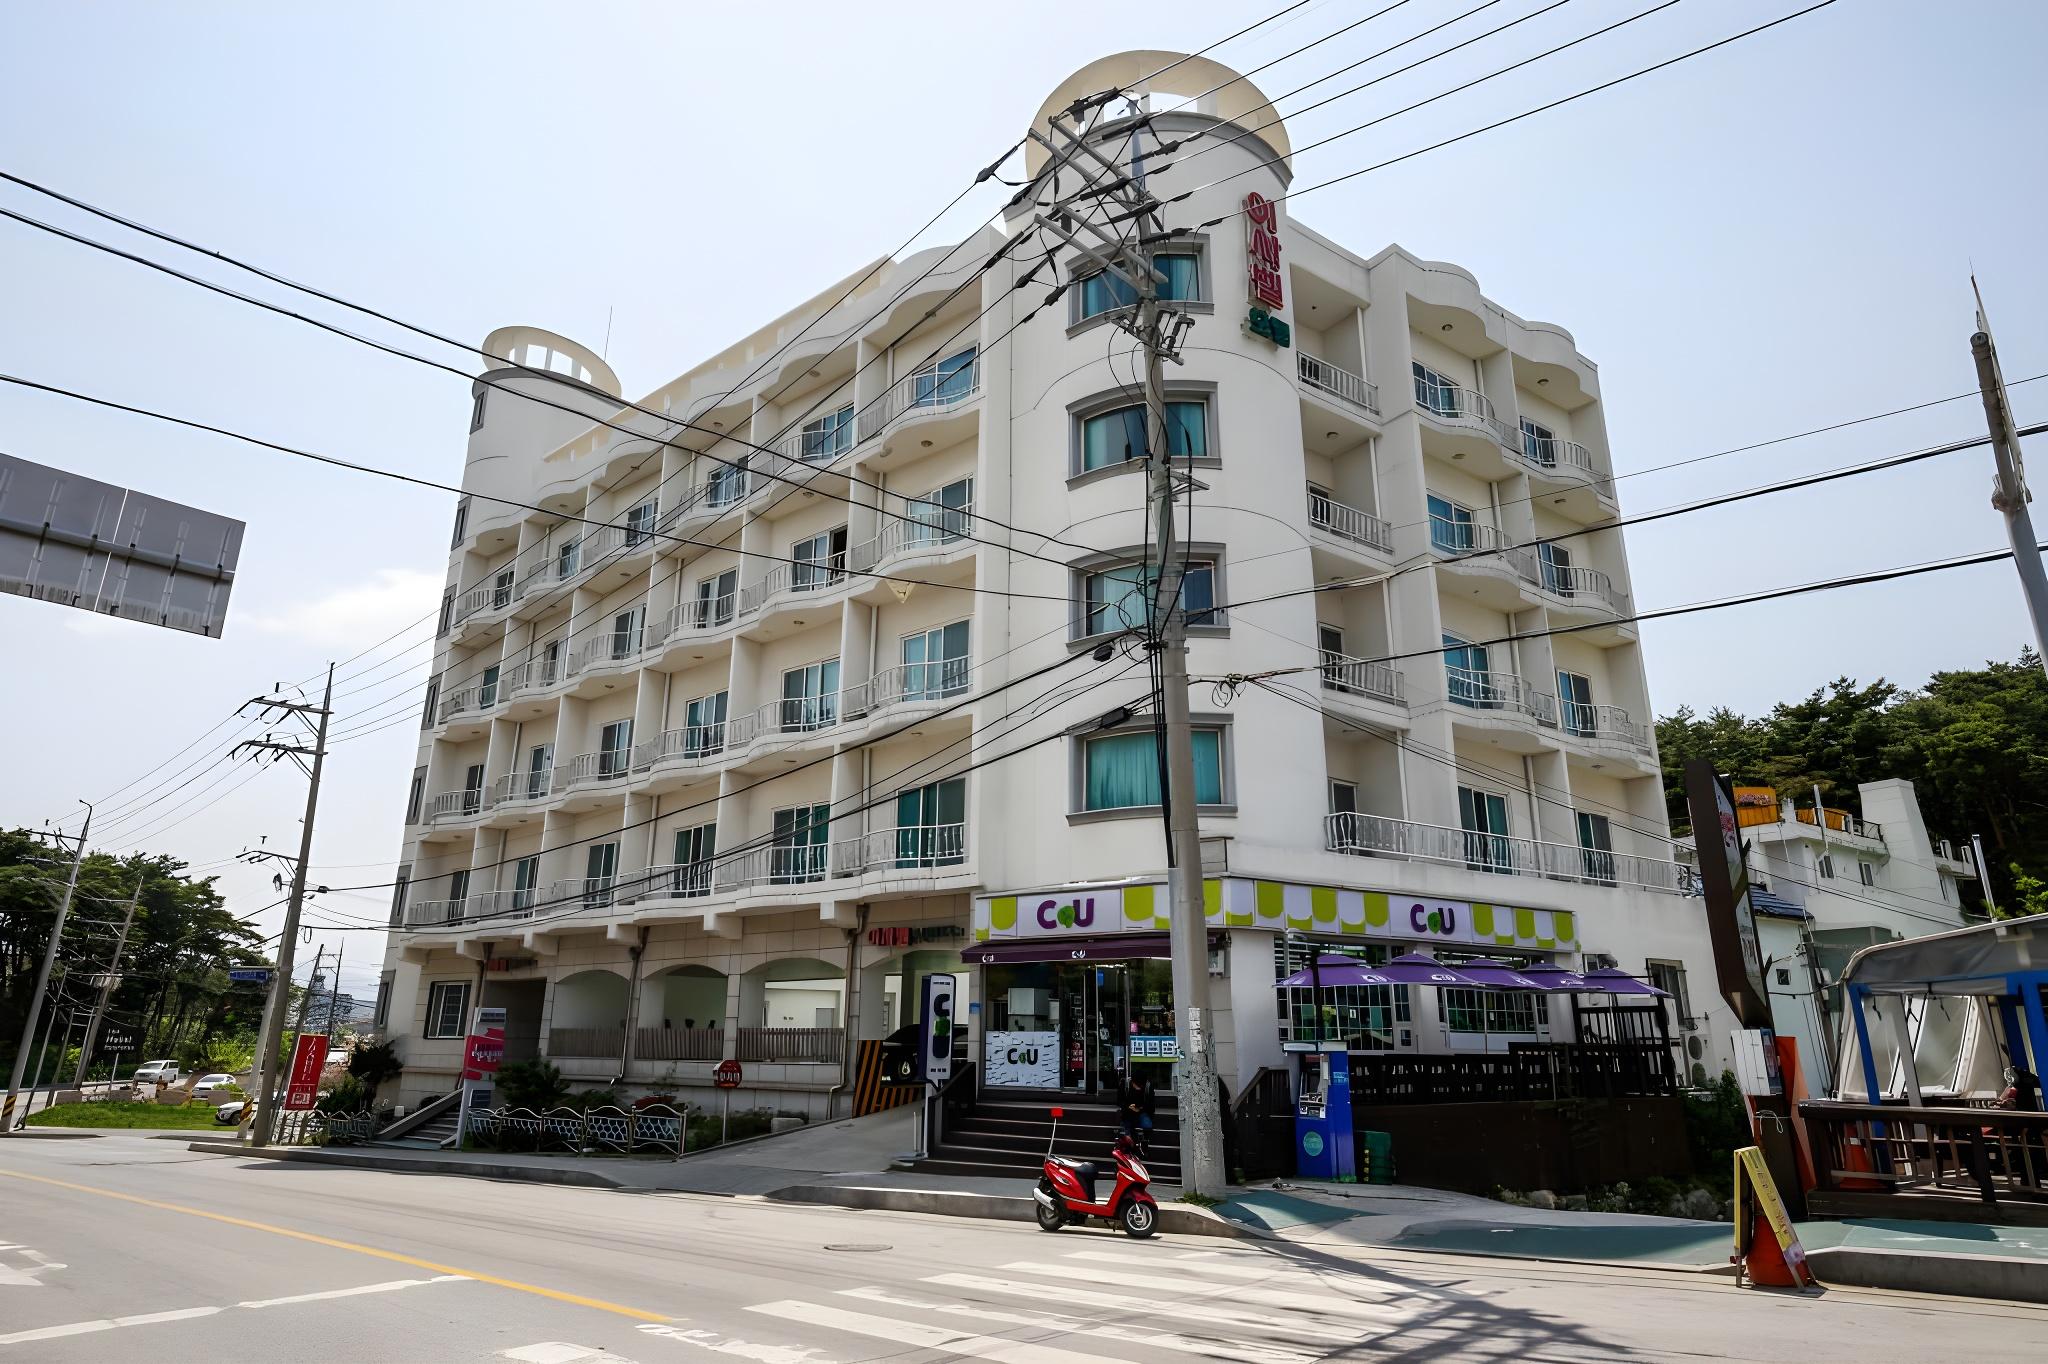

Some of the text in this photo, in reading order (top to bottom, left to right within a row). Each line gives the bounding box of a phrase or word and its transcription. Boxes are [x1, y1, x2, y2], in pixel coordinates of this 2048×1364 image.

[1036, 898, 1095, 929] CU
[1409, 903, 1456, 936] CU
[1006, 1047, 1039, 1066] CU
